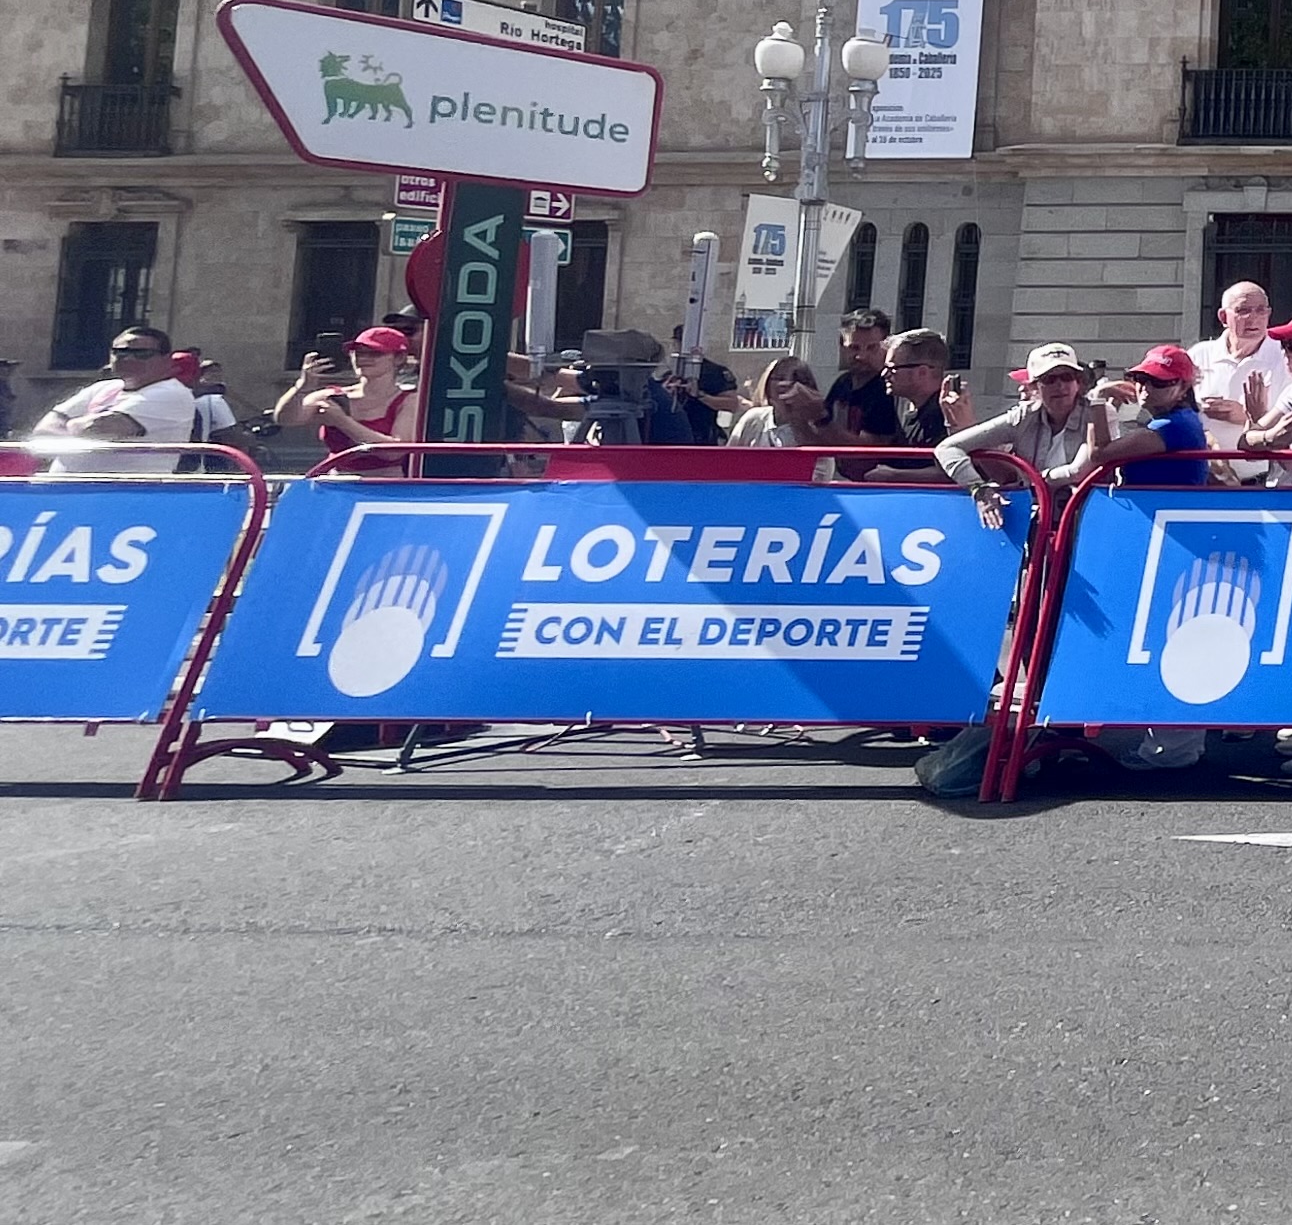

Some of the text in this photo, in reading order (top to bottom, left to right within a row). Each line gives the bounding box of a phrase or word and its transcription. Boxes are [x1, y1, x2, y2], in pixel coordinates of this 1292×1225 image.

[531, 29, 582, 51] Hortega
[880, 0, 960, 49] 175
[428, 91, 630, 143] plenitude
[521, 512, 947, 585] LOTERÍAS
[534, 615, 895, 648] CON EL DEPORTE
